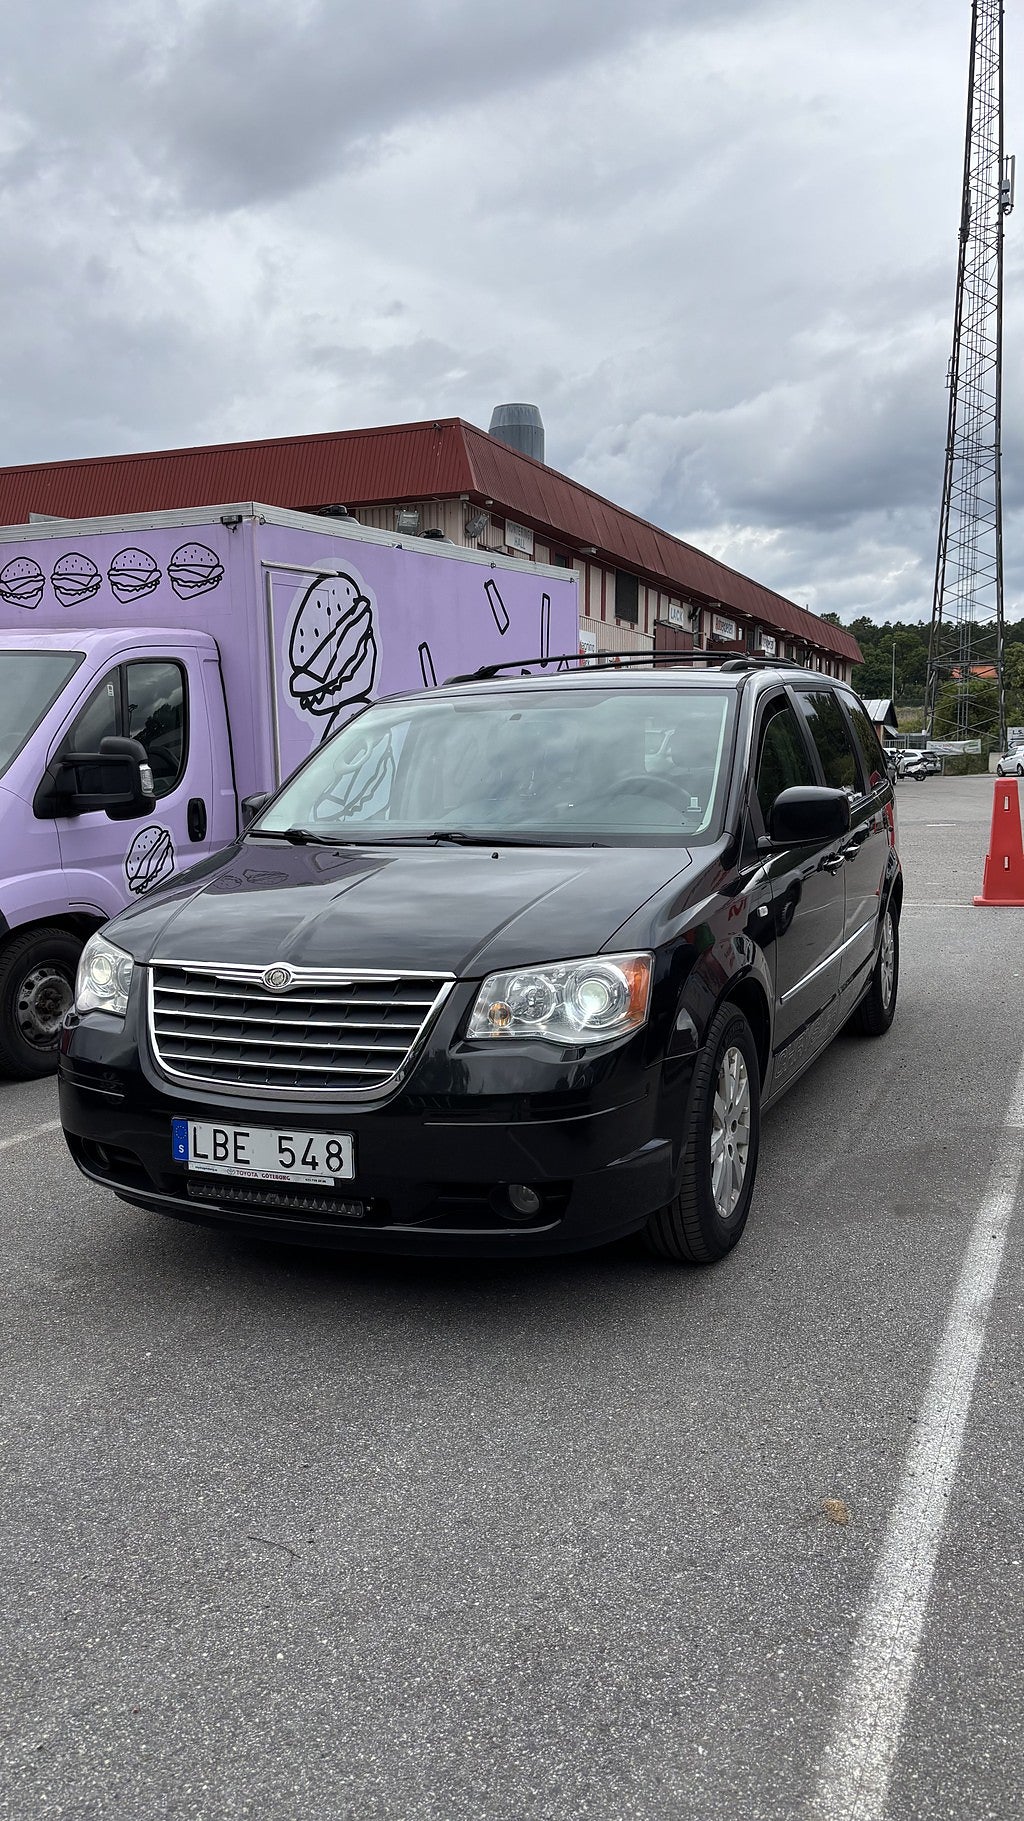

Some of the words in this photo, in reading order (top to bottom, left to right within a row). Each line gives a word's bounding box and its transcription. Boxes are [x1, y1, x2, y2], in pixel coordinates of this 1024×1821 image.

[178, 1144, 185, 1153] S
[193, 1126, 251, 1164] LBE
[278, 1134, 344, 1172] 548
[235, 1170, 259, 1178] TOYOTA
